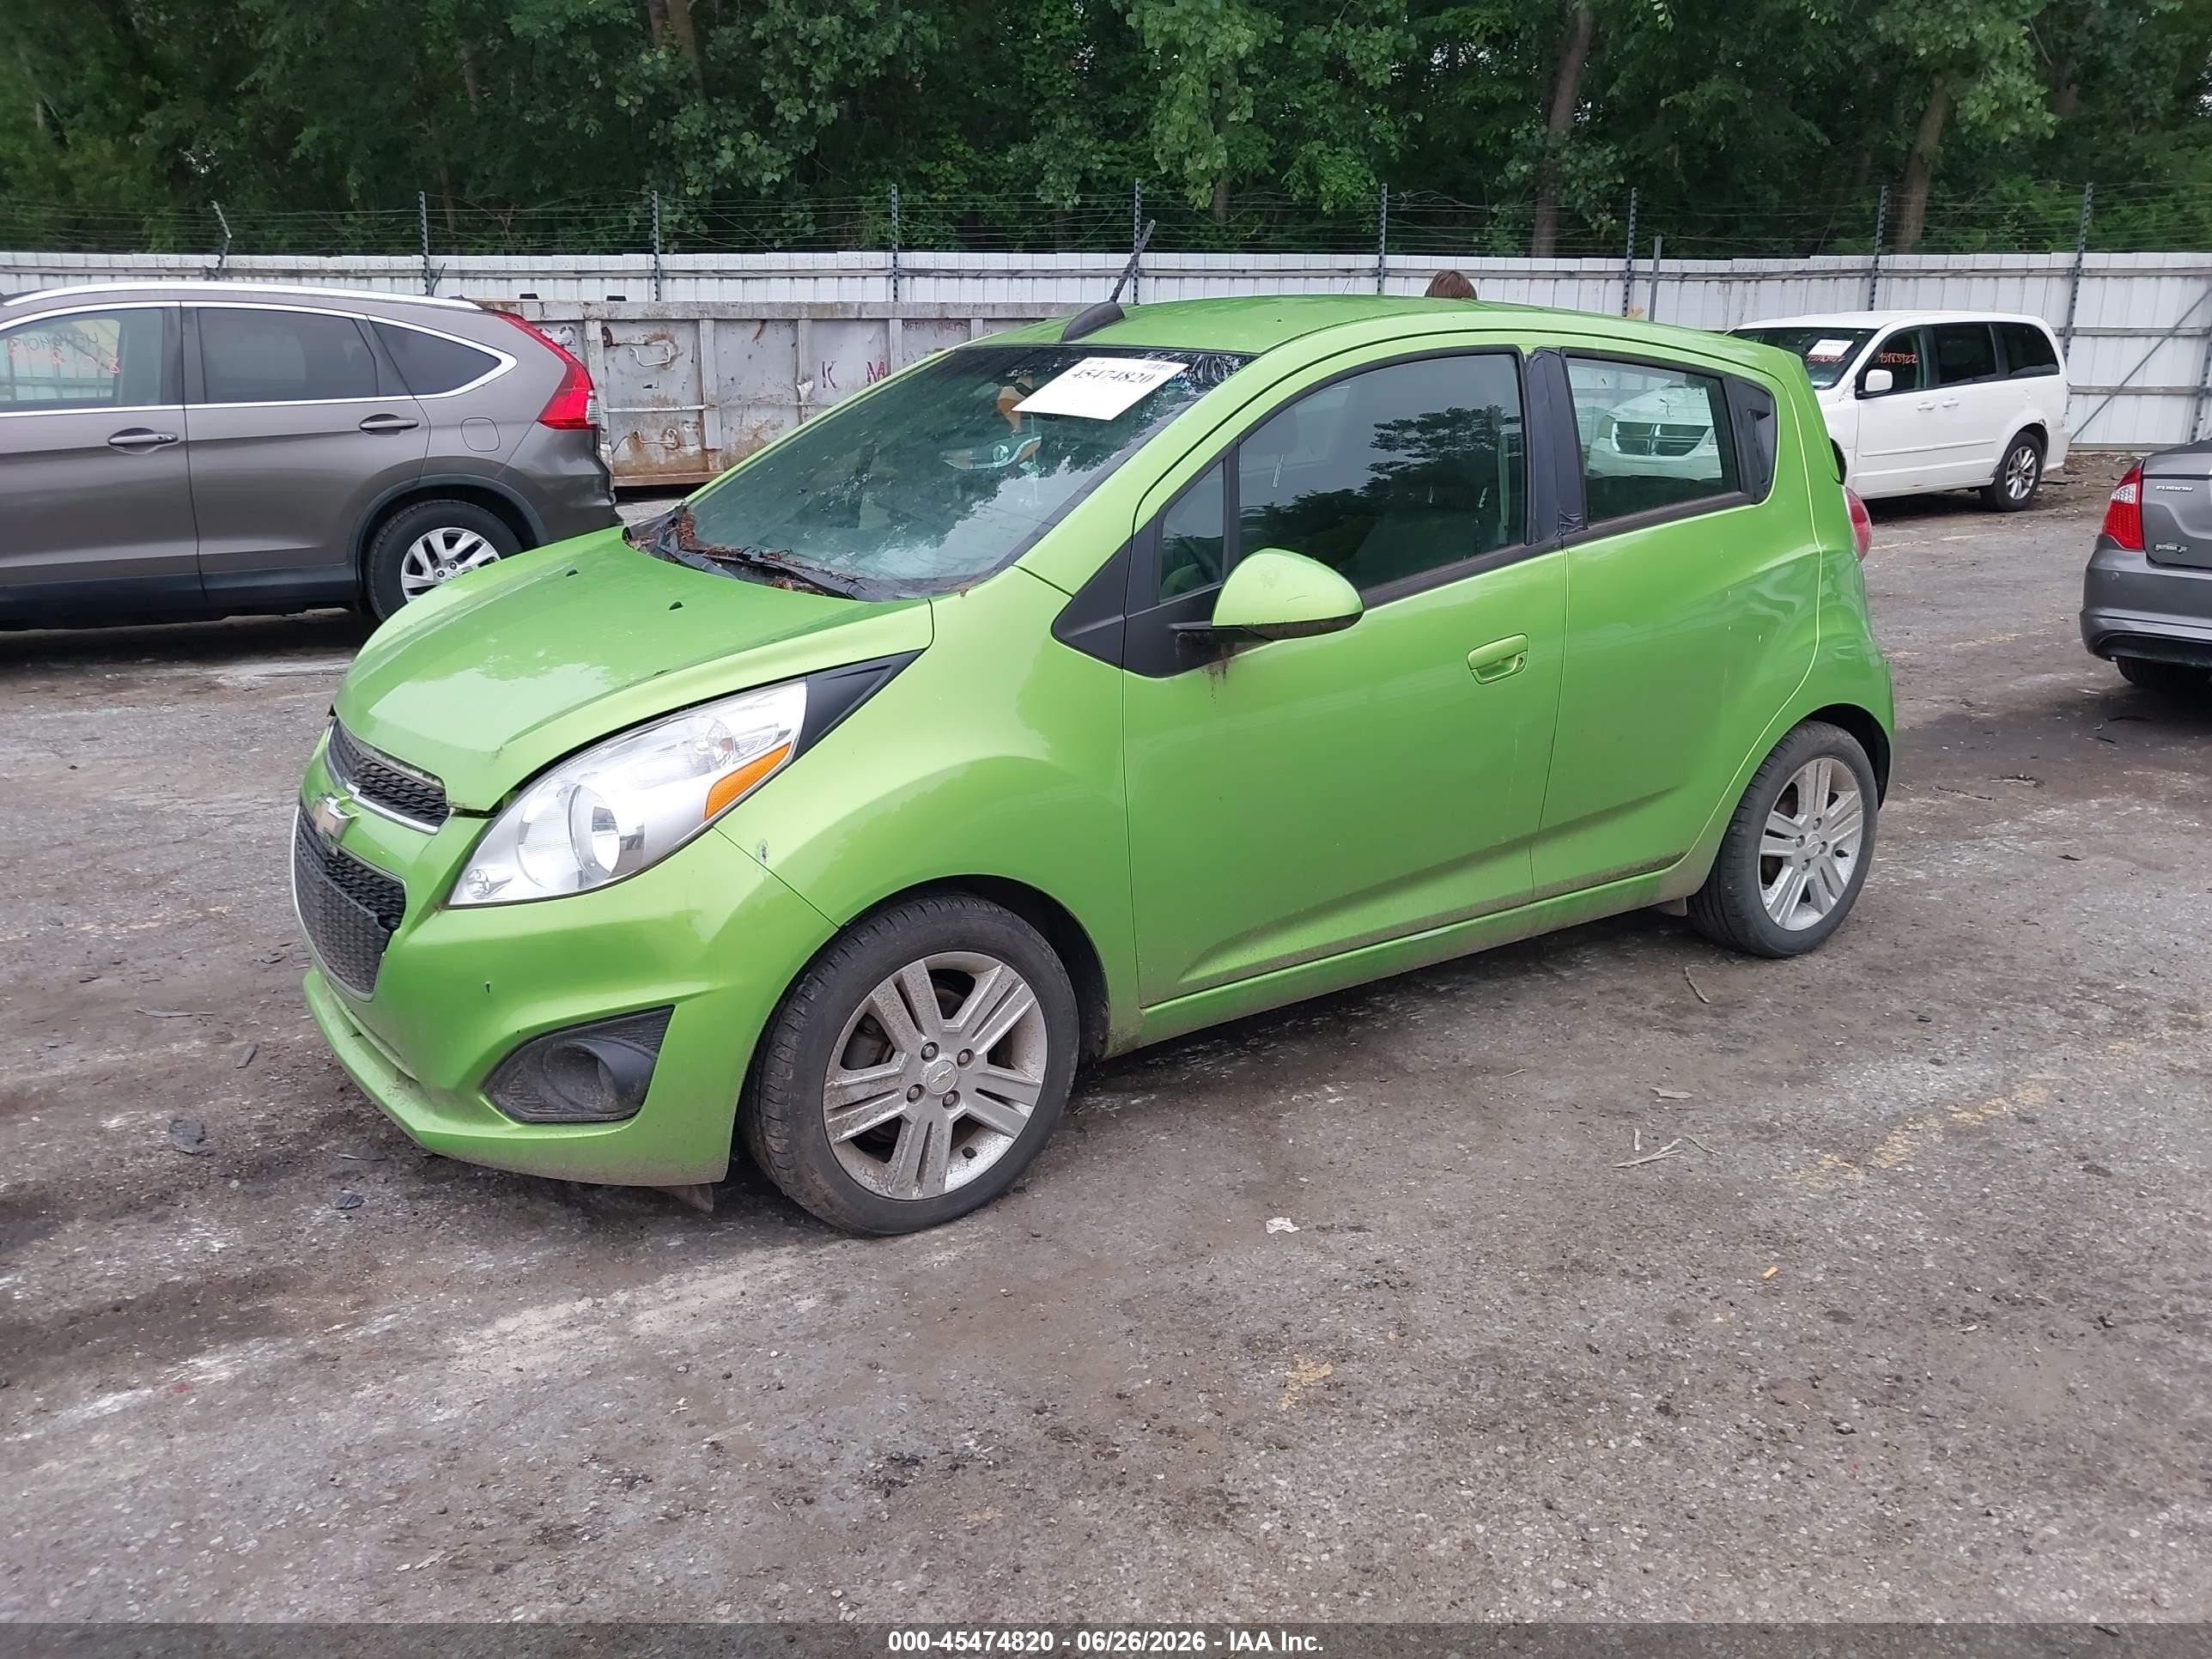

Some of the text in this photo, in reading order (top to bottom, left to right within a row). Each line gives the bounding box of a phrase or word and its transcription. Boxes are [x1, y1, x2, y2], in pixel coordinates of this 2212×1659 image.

[821, 360, 886, 390] K M
[1071, 368, 1157, 385] 45474820
